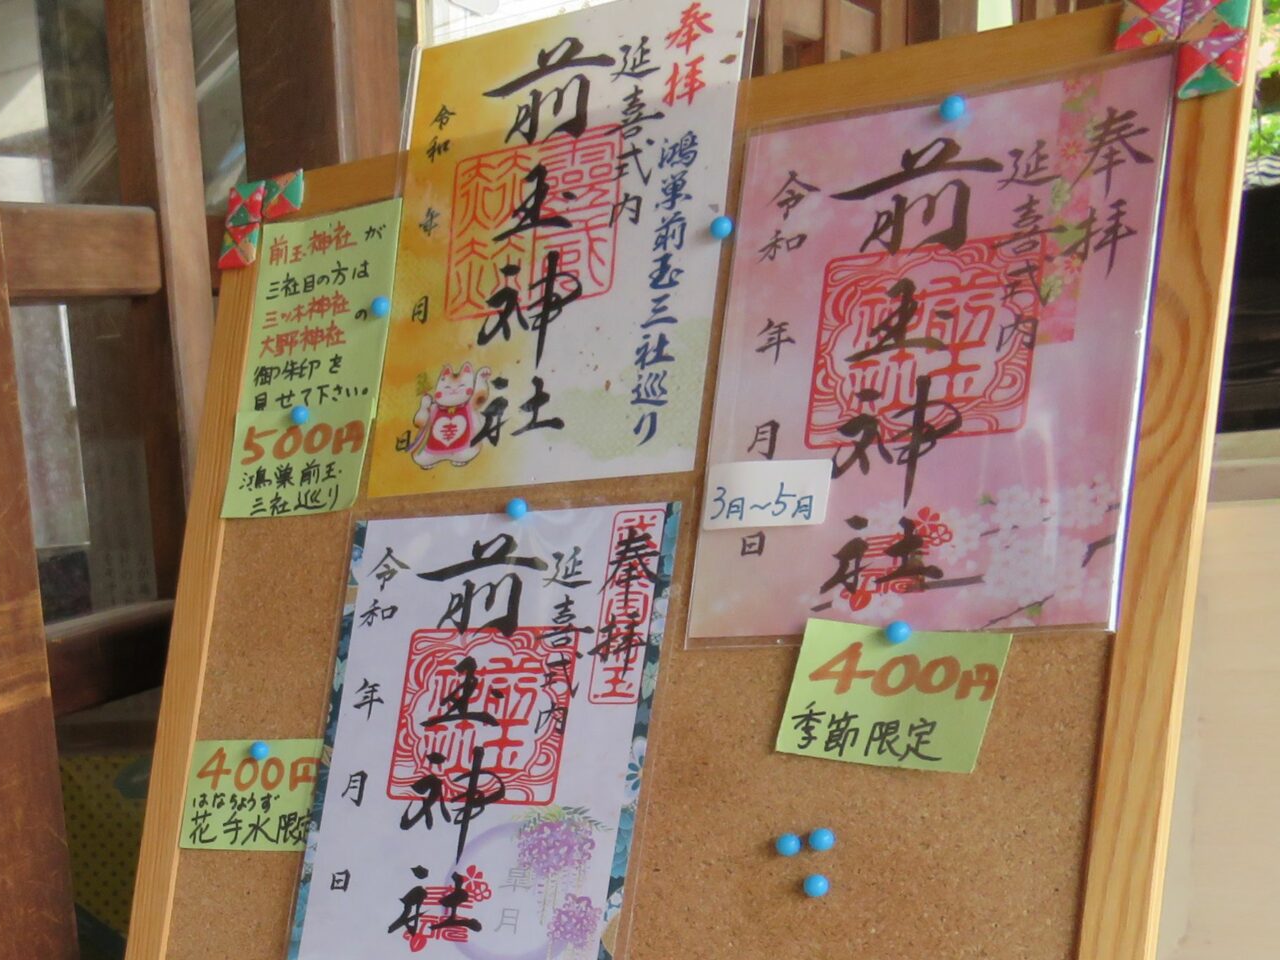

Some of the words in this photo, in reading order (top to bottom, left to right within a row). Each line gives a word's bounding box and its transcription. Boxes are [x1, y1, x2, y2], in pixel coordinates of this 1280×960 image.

[757, 169, 820, 264] 令和
[470, 36, 616, 448] 前玉神社
[265, 261, 370, 300] 三社目の方は
[630, 130, 699, 446] 鴻巣前玉三社巡り
[754, 318, 796, 365] 年
[253, 354, 344, 387] 御朱印を
[819, 136, 1004, 595] 前玉神社
[241, 420, 366, 466] 500円
[747, 419, 780, 460] 月
[249, 485, 340, 516] 三社巡り
[741, 532, 765, 559] 日
[360, 546, 410, 629] 令和
[808, 640, 1000, 702] 400円
[353, 678, 385, 721] 年
[387, 532, 550, 937] 前玉神社
[791, 701, 943, 763] 季節限定
[196, 746, 322, 793] 400円
[341, 771, 368, 808] 月
[330, 869, 351, 893] 日
